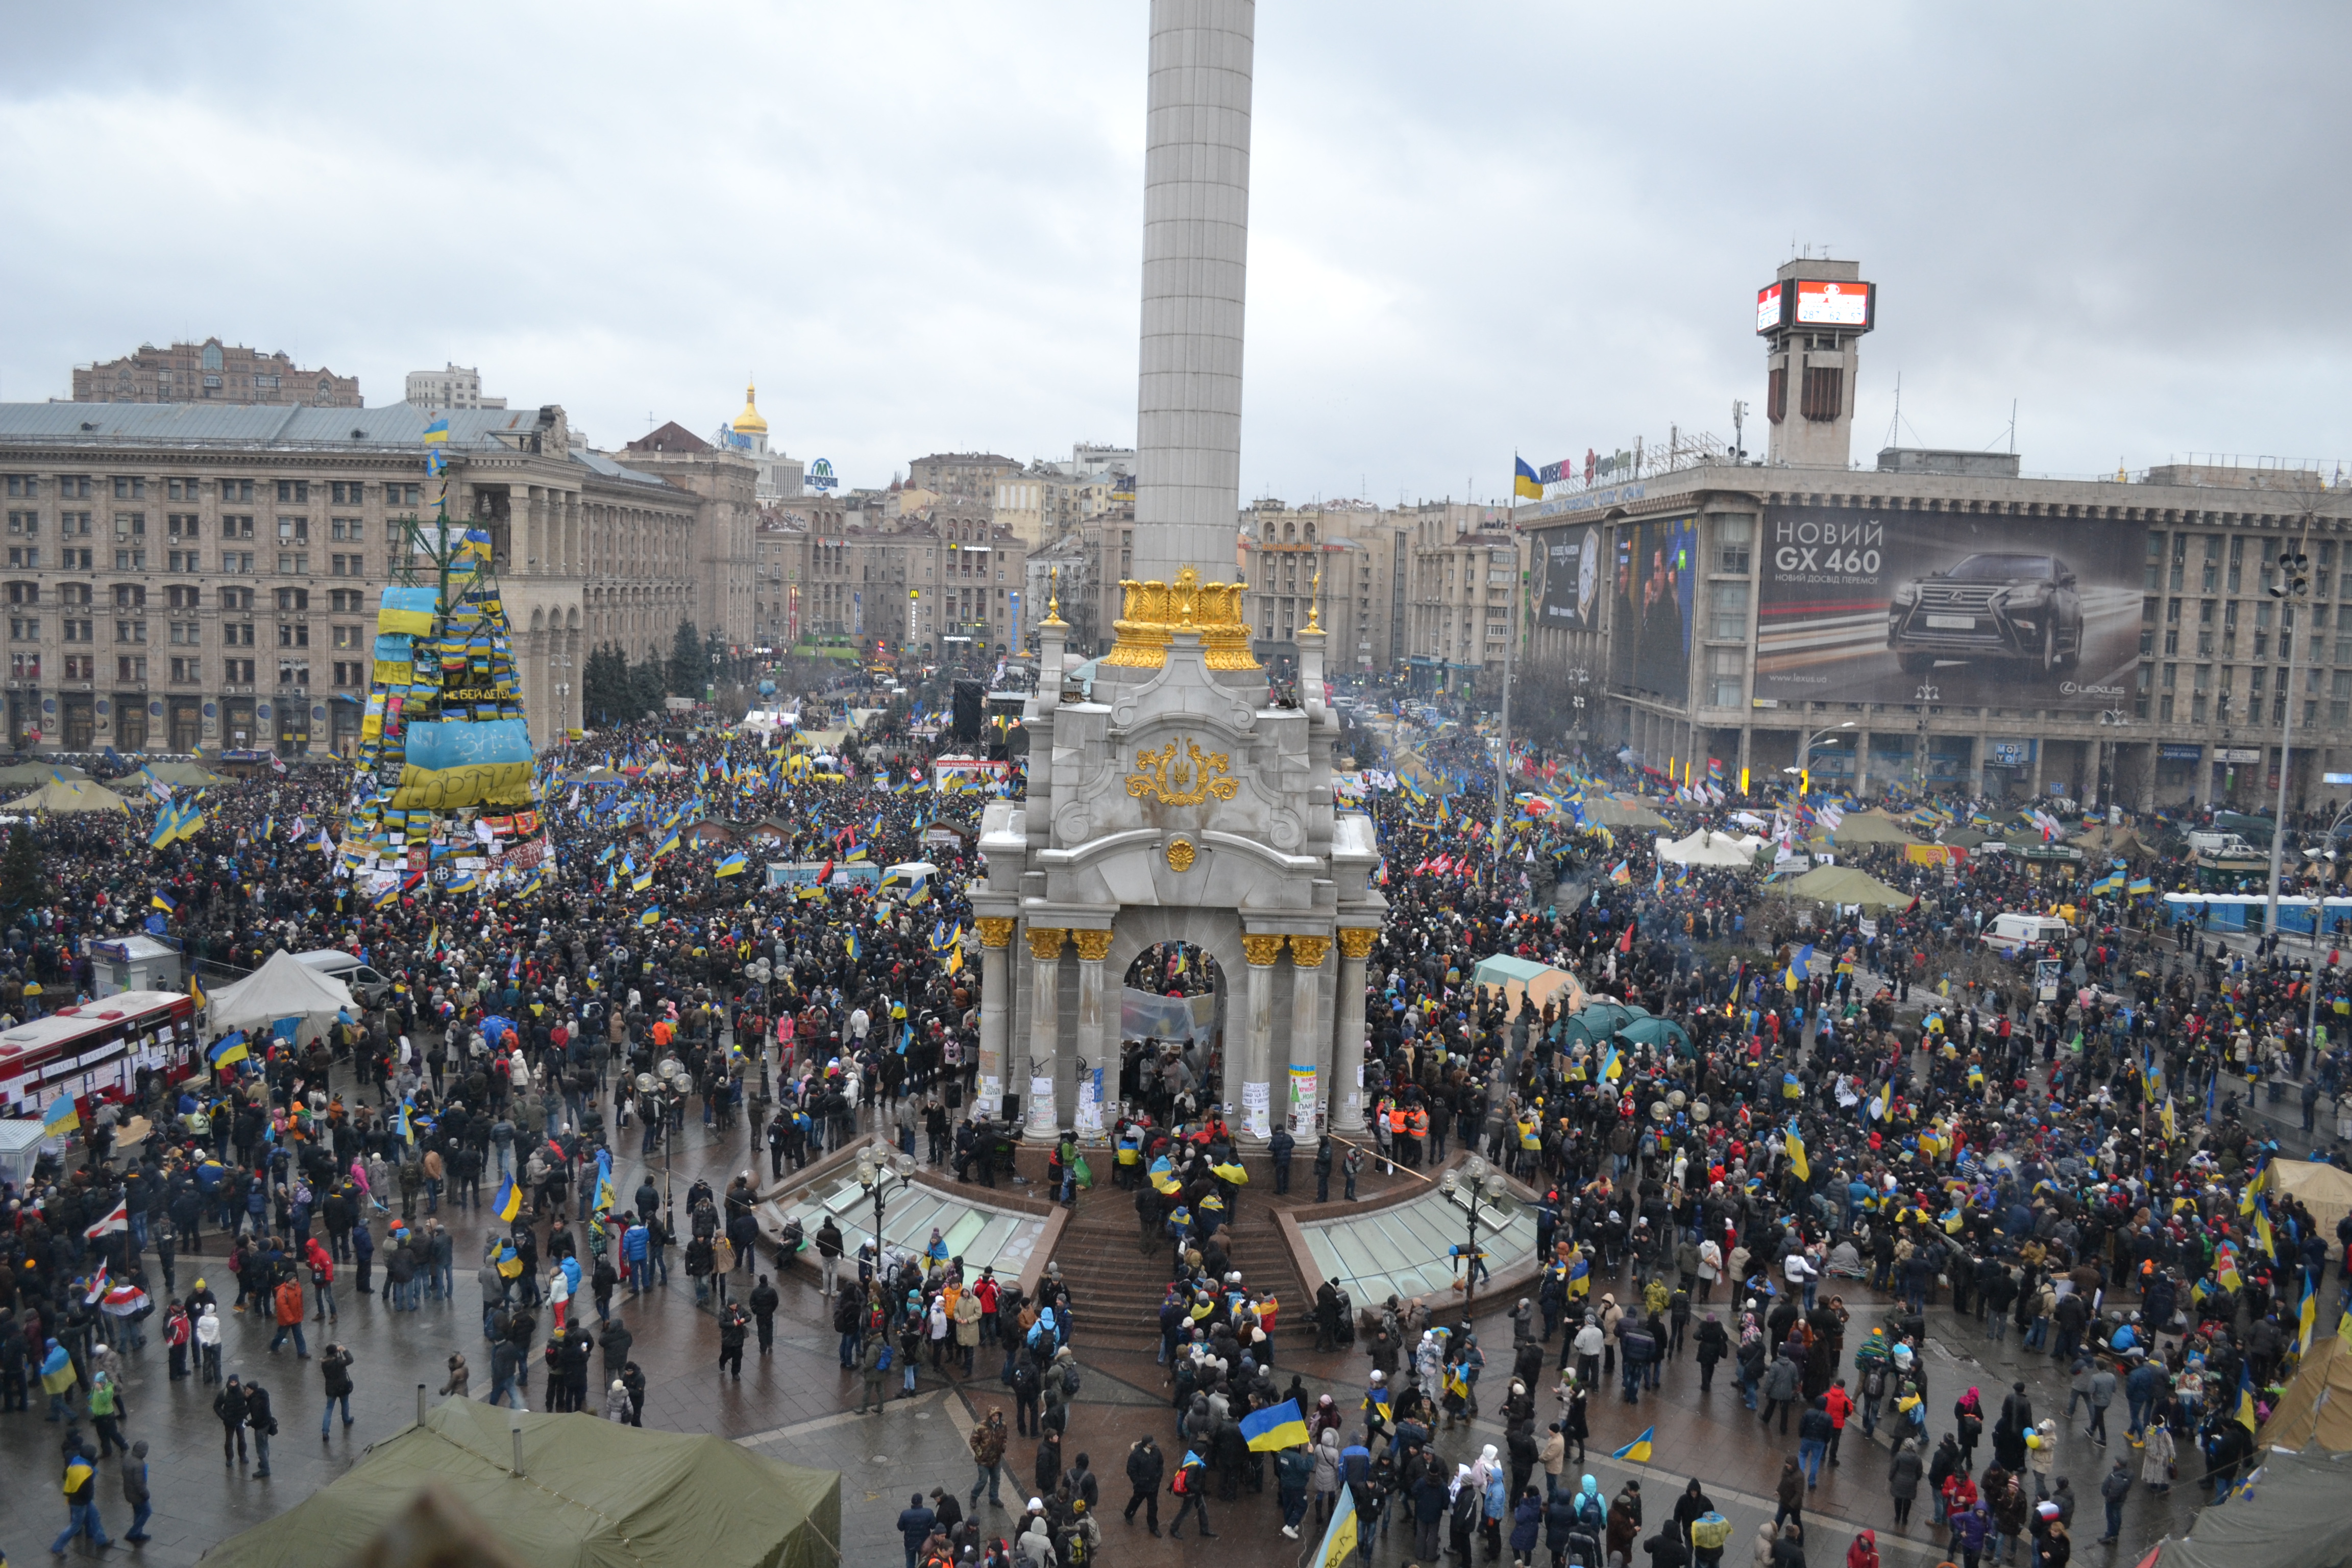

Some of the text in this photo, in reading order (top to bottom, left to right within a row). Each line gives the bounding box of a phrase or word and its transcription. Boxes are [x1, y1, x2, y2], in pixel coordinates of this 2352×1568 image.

[1829, 311, 1841, 320] 62
[1850, 312, 1861, 321] 57
[1777, 520, 1882, 546] НОВИЙ
[1263, 543, 1311, 552] КОЗАЦЬКИЙ
[1775, 546, 1880, 574] GX 460
[1775, 573, 1879, 585] НОВИЙ ДОСВІД ПЕРЕМОГ
[1769, 673, 1827, 683] www.lexus.ua
[444, 690, 458, 700] НЕ
[460, 688, 482, 700] БЕЙ
[2078, 685, 2125, 694] LEXUS
[42, 1061, 77, 1077] ОБЛАСТЬ
